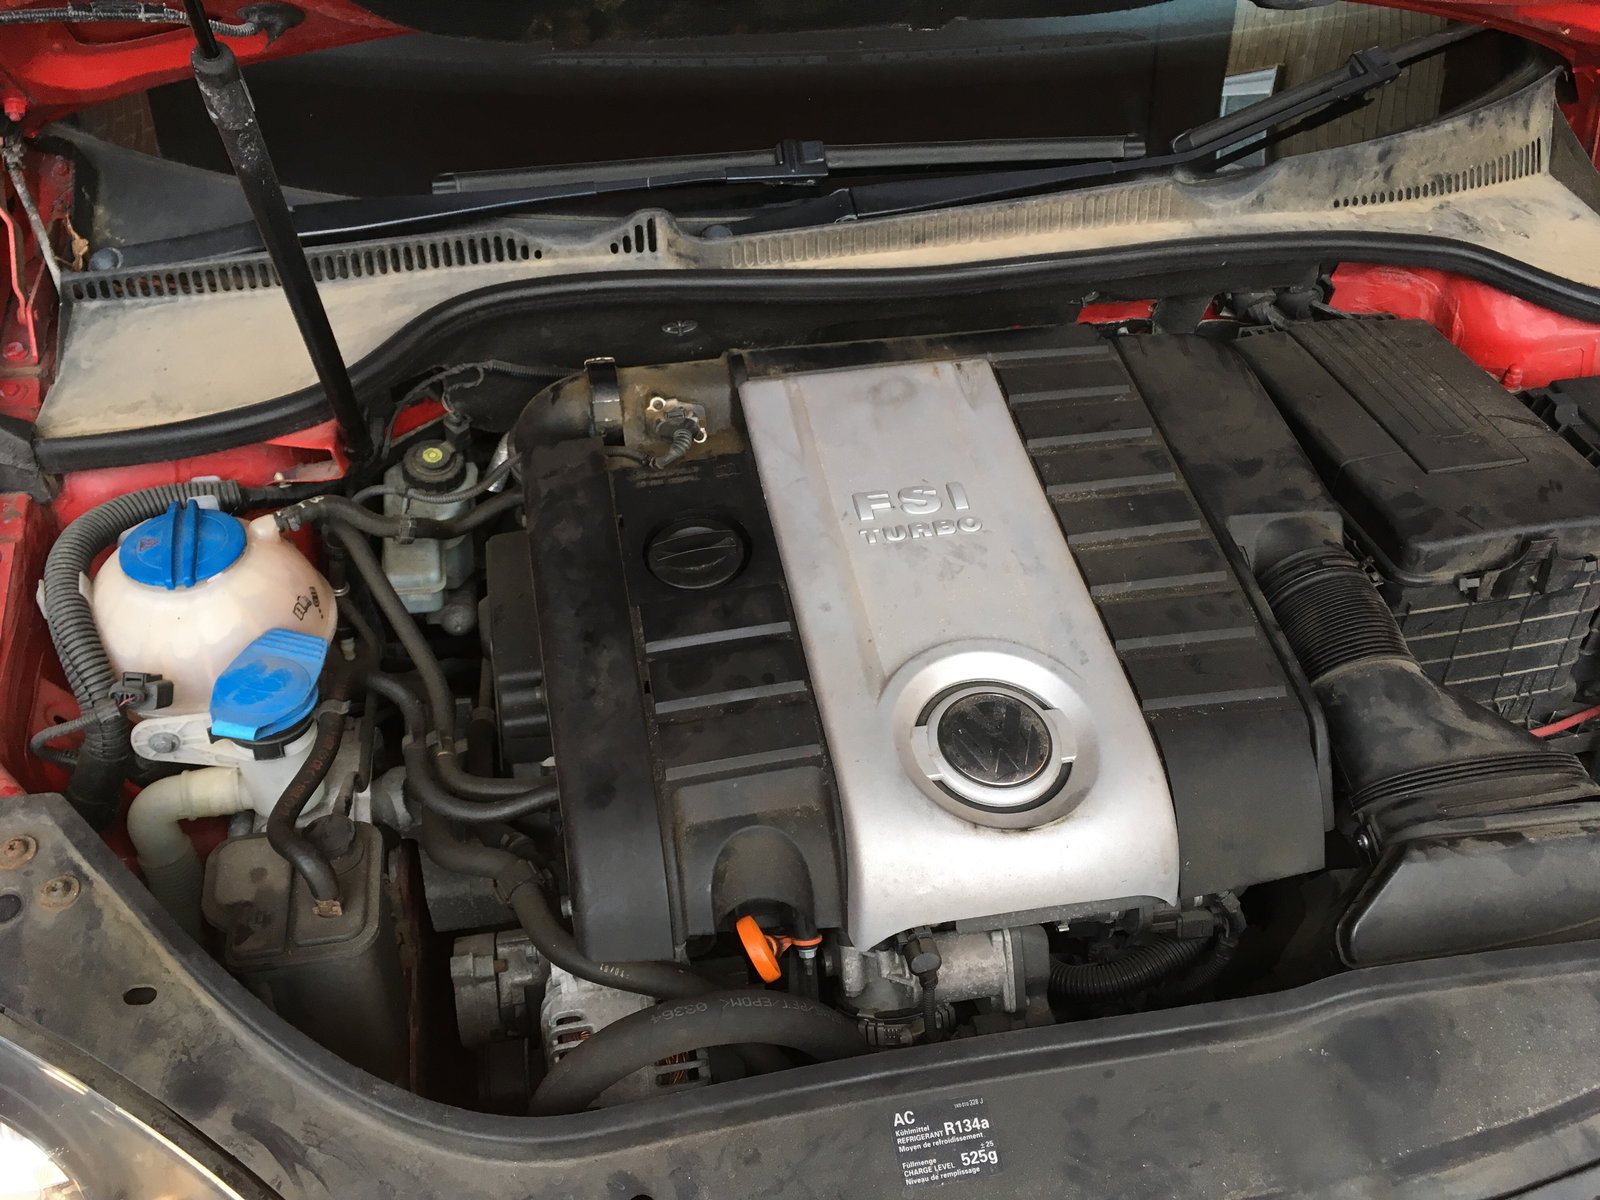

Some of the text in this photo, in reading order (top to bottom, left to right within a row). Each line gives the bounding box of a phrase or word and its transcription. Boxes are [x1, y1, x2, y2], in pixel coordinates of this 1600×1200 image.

[852, 482, 970, 521] FSI
[859, 516, 982, 544] TURBO
[894, 1110, 915, 1127] AC
[895, 1125, 930, 1137] Kühlmittel
[897, 1117, 990, 1145] REFRIGERANT R134a
[898, 1144, 922, 1152] Moyen
[932, 1132, 984, 1146] refroidissement
[902, 1158, 937, 1170] Füllmenge
[960, 1150, 998, 1166] 525g
[904, 1162, 956, 1178] CHARGE LEVEL
[905, 1177, 930, 1186] Niveau
[940, 1166, 980, 1179] remplissage
